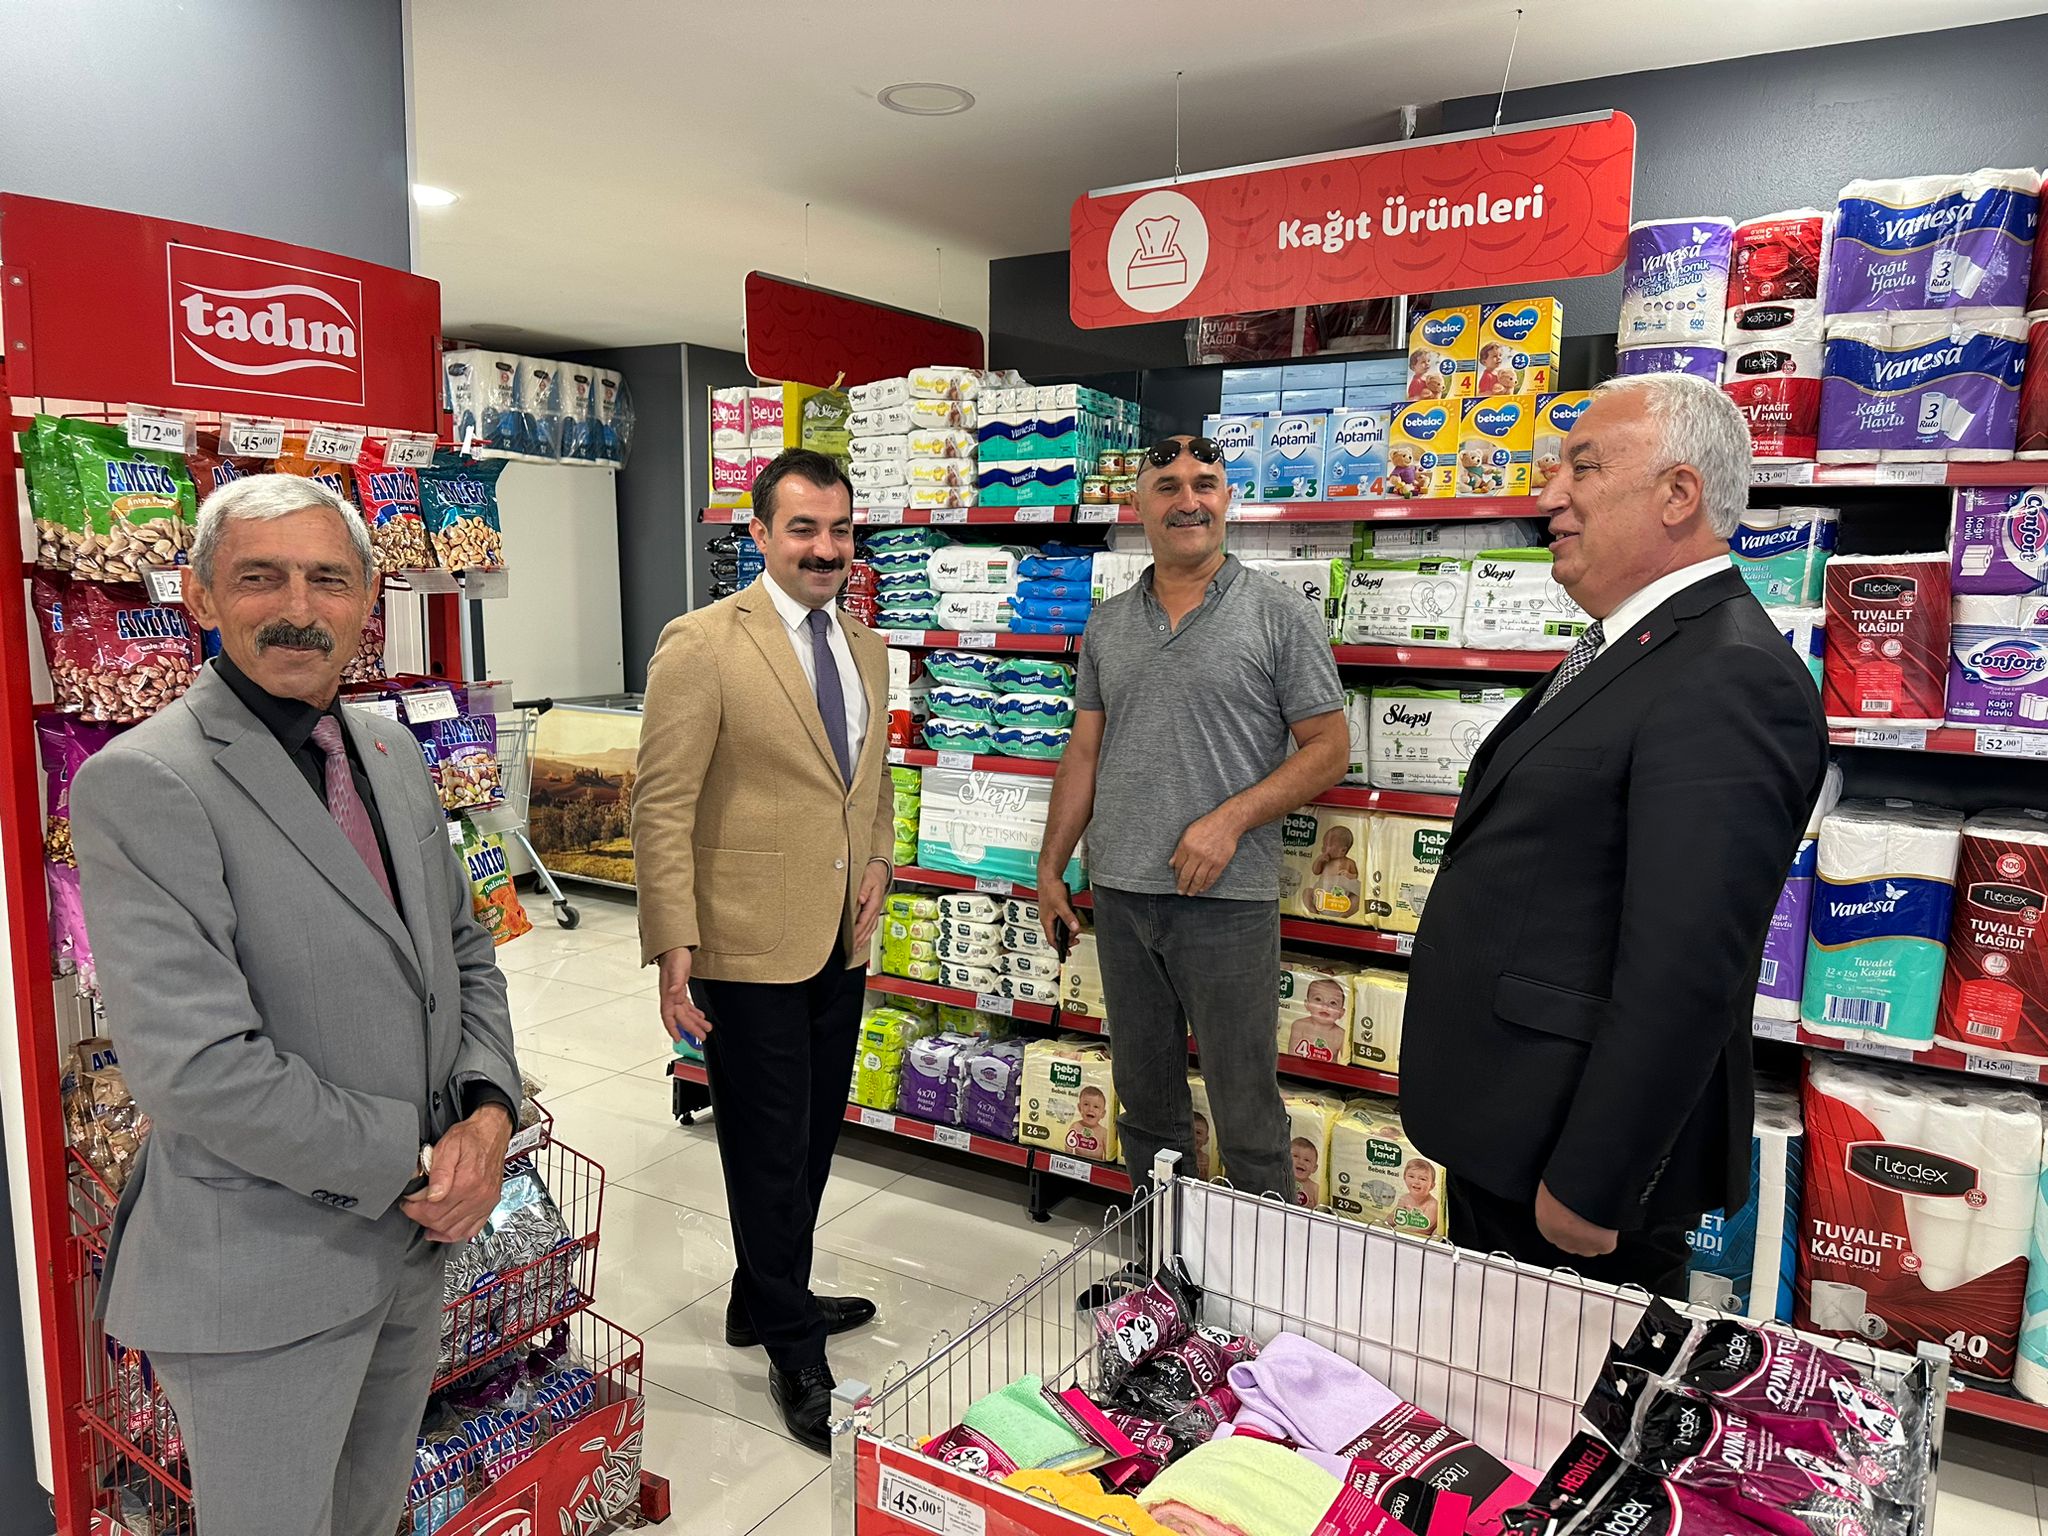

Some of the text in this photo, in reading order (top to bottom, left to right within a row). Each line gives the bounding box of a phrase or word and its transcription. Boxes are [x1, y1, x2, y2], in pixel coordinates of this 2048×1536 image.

[1278, 184, 1545, 254] Kağıt Ürünleri
[1883, 201, 1977, 242] Vanesa
[1642, 242, 1703, 272] Vanesa
[1867, 261, 1908, 277] Kağıt
[1937, 261, 1951, 278] 3
[1871, 273, 1916, 292] Havlu
[180, 293, 357, 358] tadım
[1424, 323, 1461, 334] bebelac
[1496, 317, 1534, 328] bebelac
[1690, 318, 1704, 327] 600
[1874, 346, 1963, 383] Vanesa
[1461, 376, 1472, 389] 4
[1534, 370, 1545, 384] 4
[1761, 402, 1790, 412] KAĞIT
[1856, 400, 1896, 417] Kağıt
[1925, 404, 1940, 420] 3
[1405, 416, 1442, 427] bebelac
[1477, 414, 1516, 424] bebelac
[1761, 412, 1793, 420] HAVLU
[1859, 412, 1905, 430] Havlu
[1919, 420, 1939, 428] Rulo
[1270, 432, 1317, 448] Aptamil
[1335, 429, 1384, 445] Aptamil
[714, 467, 747, 484] Beyaz
[1442, 470, 1452, 483] 3
[1515, 468, 1526, 481] 2
[1244, 481, 1256, 498] 2
[1305, 478, 1318, 497] 3
[1370, 477, 1384, 495] 4
[2021, 494, 2044, 562] Confort
[1741, 529, 1799, 550] Vanesa
[1478, 563, 1516, 581] Sleepy
[1352, 573, 1384, 589] Sleepy
[1852, 609, 1913, 621] TUVALET
[1858, 618, 1904, 632] KAĞIDI
[1969, 652, 2045, 671] Confort
[1021, 674, 1043, 684] Vanesa
[1022, 702, 1043, 713] Vanesa
[1988, 700, 2013, 709] Kağıt
[1383, 704, 1433, 729] Sleepy
[1986, 709, 2013, 717] Havlu
[959, 771, 1030, 813] Sleepy
[1284, 816, 1316, 829] bebe
[979, 825, 1029, 841] YETİŞKİN
[1286, 826, 1310, 839] land
[923, 843, 936, 854] 30
[1414, 866, 1435, 875] Bebek
[1830, 898, 1896, 917] Vanesa
[1970, 919, 2035, 938] TUVALET
[1975, 932, 2024, 951] KAĞIDI
[1854, 957, 1894, 967] Tuvalet
[1860, 967, 1896, 977] Kağıdı
[1296, 1040, 1310, 1058] 4
[1359, 1047, 1371, 1056] 58
[1054, 1064, 1080, 1075] bebe
[1057, 1072, 1076, 1082] land
[917, 1088, 936, 1099] 4x70
[977, 1101, 996, 1113] 4x70
[1027, 1126, 1038, 1135] 26
[1066, 1130, 1078, 1148] 6
[1370, 1141, 1400, 1153] bebe
[1374, 1150, 1395, 1161] land
[1338, 1199, 1350, 1209] 29
[1395, 1210, 1407, 1226] 5
[1813, 1219, 1907, 1250] TUVALET
[1811, 1238, 1881, 1267] KAĞIDI
[1868, 1319, 1876, 1328] 2
[1945, 1331, 1988, 1358] 40
[1766, 1353, 1795, 1406] OVMA
[1403, 1434, 1421, 1451] CAM
[1426, 1426, 1450, 1454] JUMBO
[1381, 1446, 1404, 1470] BEZİ
[1396, 1448, 1426, 1475] MİKRO
[1557, 1440, 1609, 1493] HEDİYELİ
[1353, 1472, 1366, 1492] CAM
[1363, 1471, 1380, 1499] MİKRO
